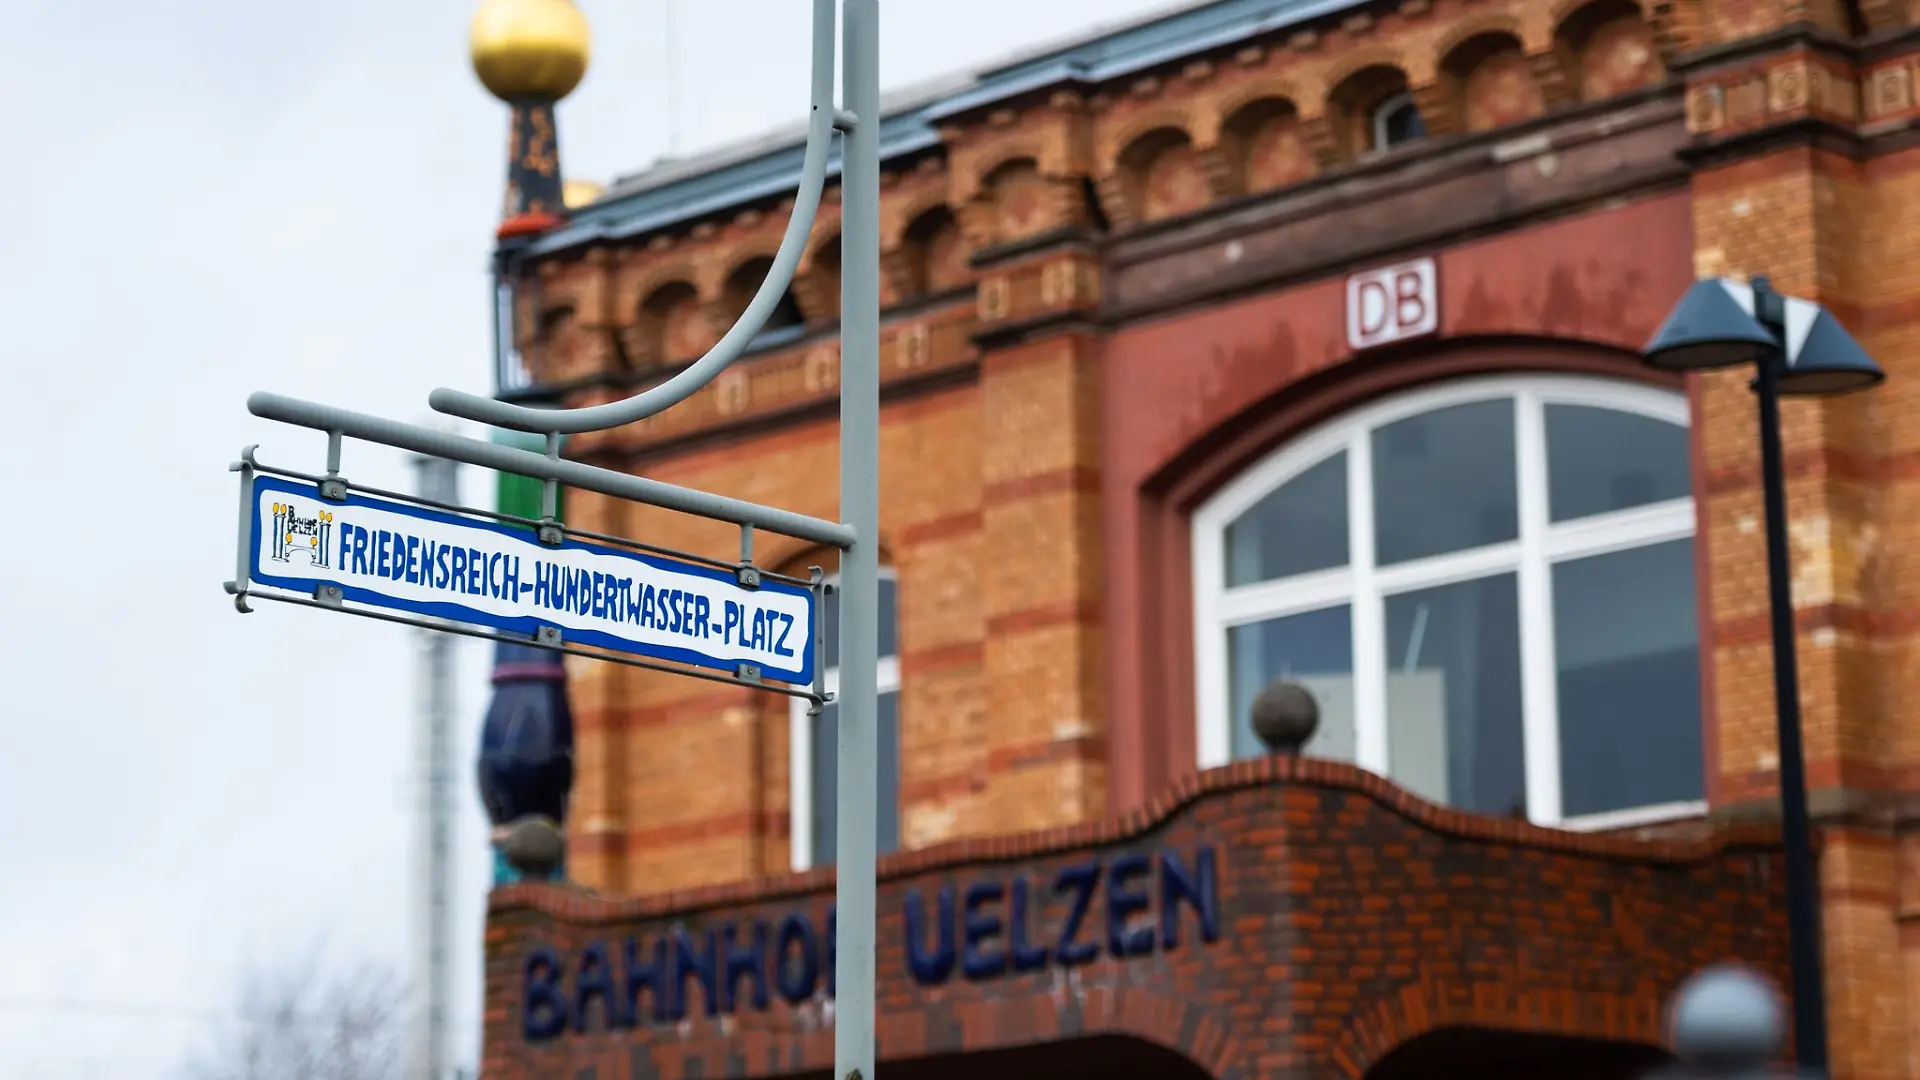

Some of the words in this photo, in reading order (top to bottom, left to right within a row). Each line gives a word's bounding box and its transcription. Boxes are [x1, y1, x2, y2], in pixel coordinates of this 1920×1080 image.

[1358, 270, 1427, 336] DB
[338, 522, 794, 657] FRIEDENSREICH-HUNDERTWASSER-PLATZ
[523, 903, 836, 1042] BAHNHO
[905, 846, 1219, 986] UELZEN
